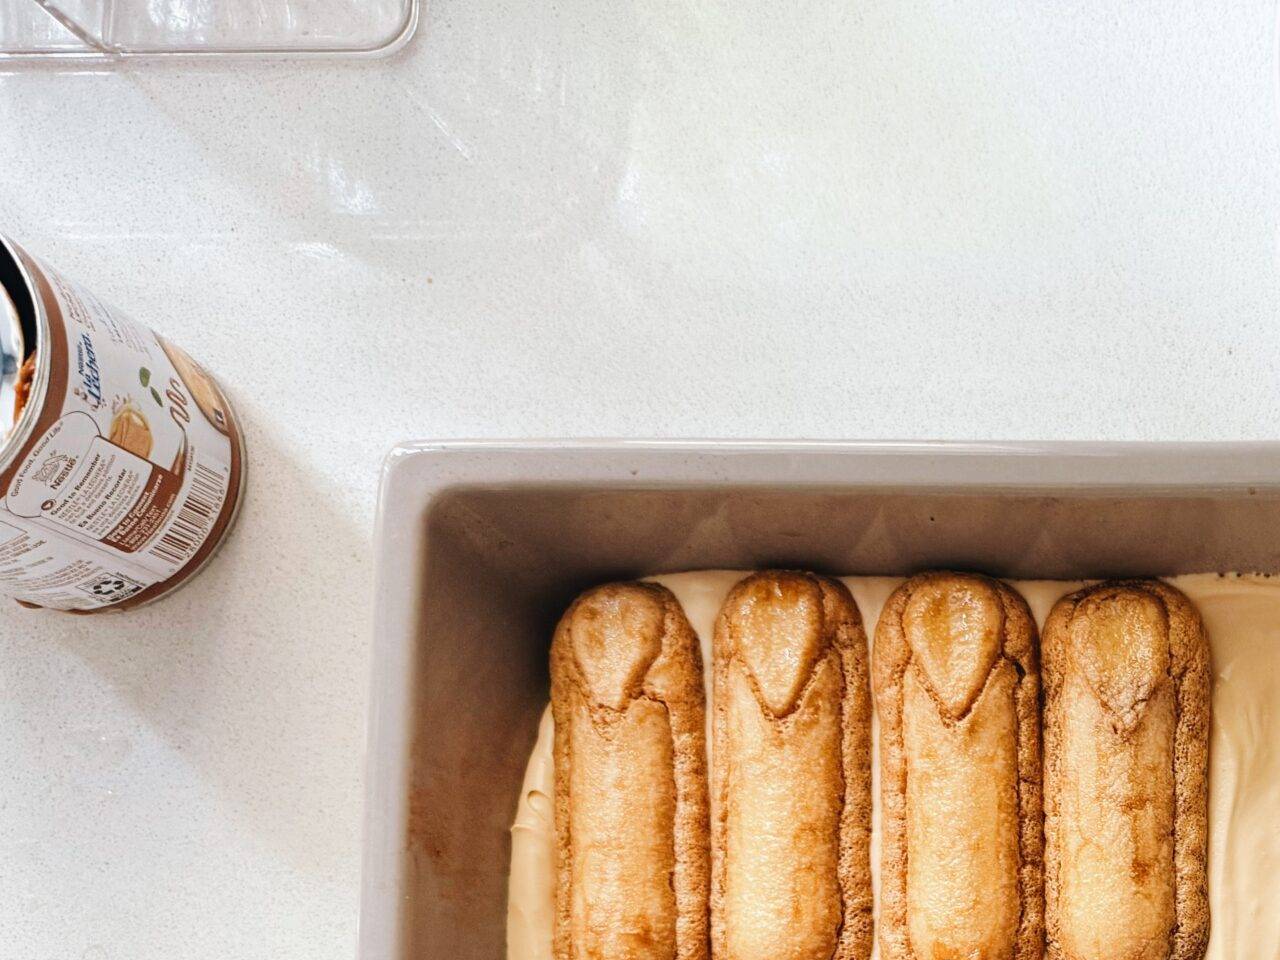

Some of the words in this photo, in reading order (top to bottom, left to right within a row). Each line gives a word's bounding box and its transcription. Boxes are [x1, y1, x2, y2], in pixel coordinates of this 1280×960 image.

[9, 477, 23, 497] Good
[31, 435, 50, 457] Good
[49, 498, 69, 516] Good
[66, 490, 77, 499] to
[73, 452, 101, 491] Remember
[77, 519, 88, 528] Es
[86, 499, 106, 520] Bueno
[104, 468, 127, 500] Recordar
